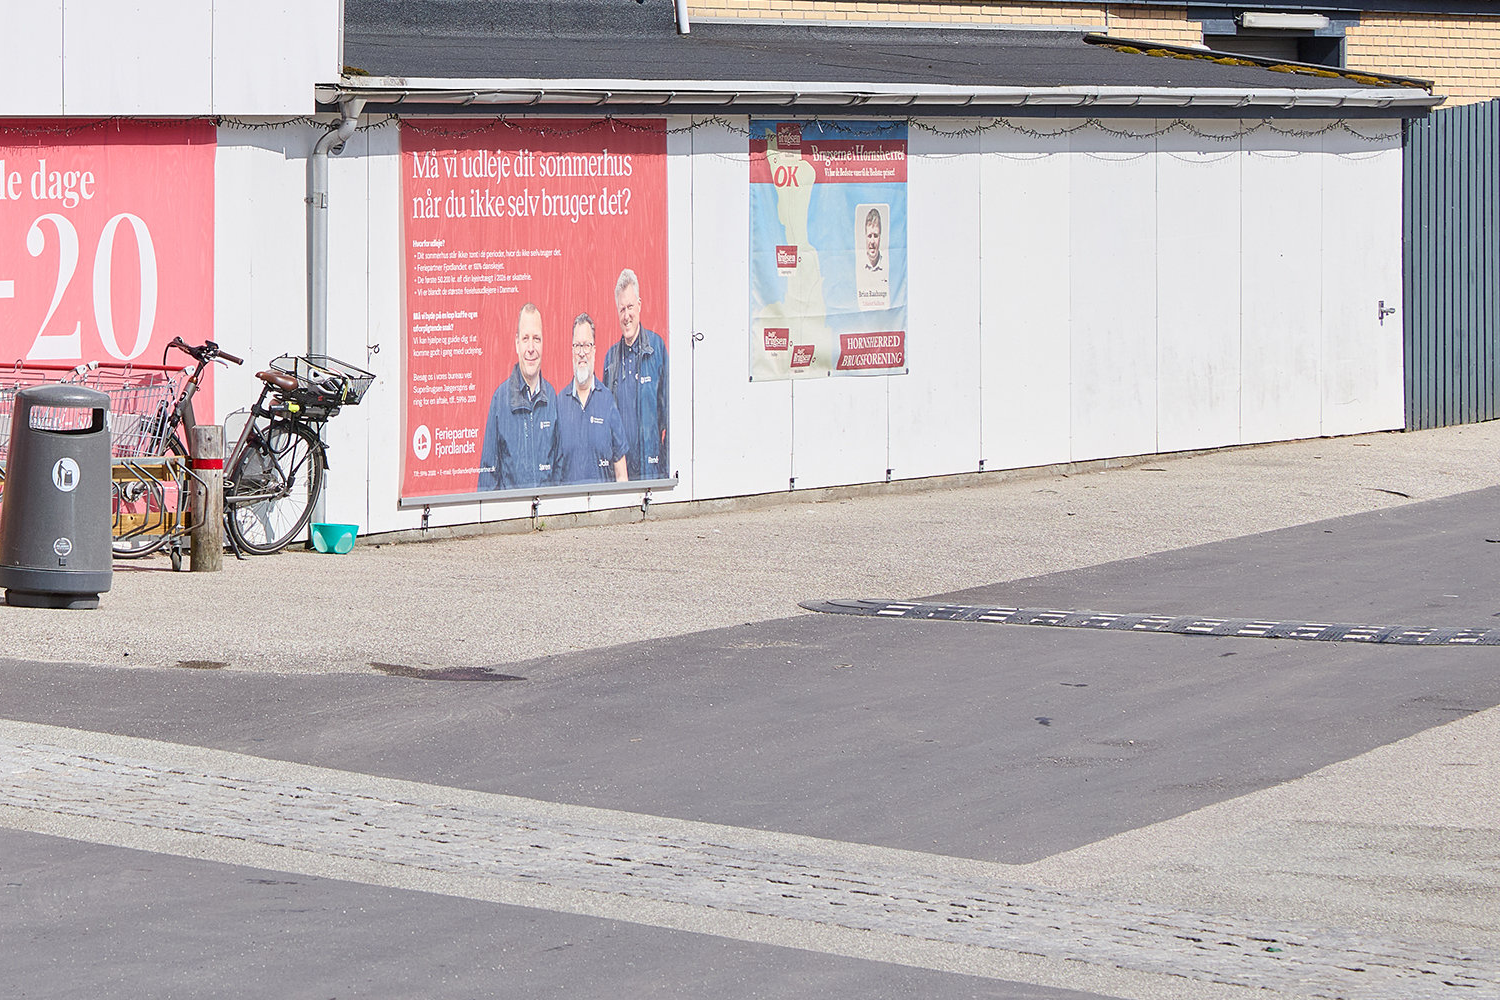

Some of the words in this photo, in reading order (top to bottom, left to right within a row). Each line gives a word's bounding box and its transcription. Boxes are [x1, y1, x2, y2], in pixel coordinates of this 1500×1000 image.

[412, 149, 439, 178] Må
[443, 149, 458, 178] vi
[462, 149, 510, 184] udleje
[514, 149, 535, 177] dit
[539, 149, 632, 177] sommerhus
[773, 166, 799, 187] OK
[30, 159, 96, 208] dage
[412, 188, 442, 218] når
[445, 190, 465, 217] du
[470, 190, 504, 217] ikke
[508, 188, 540, 217] selv
[542, 188, 596, 223] bruger
[598, 187, 632, 215] det?
[847, 335, 900, 349] HORNSHERRED
[435, 427, 478, 442] Feriepartner
[435, 440, 476, 458] Fjordlandet
